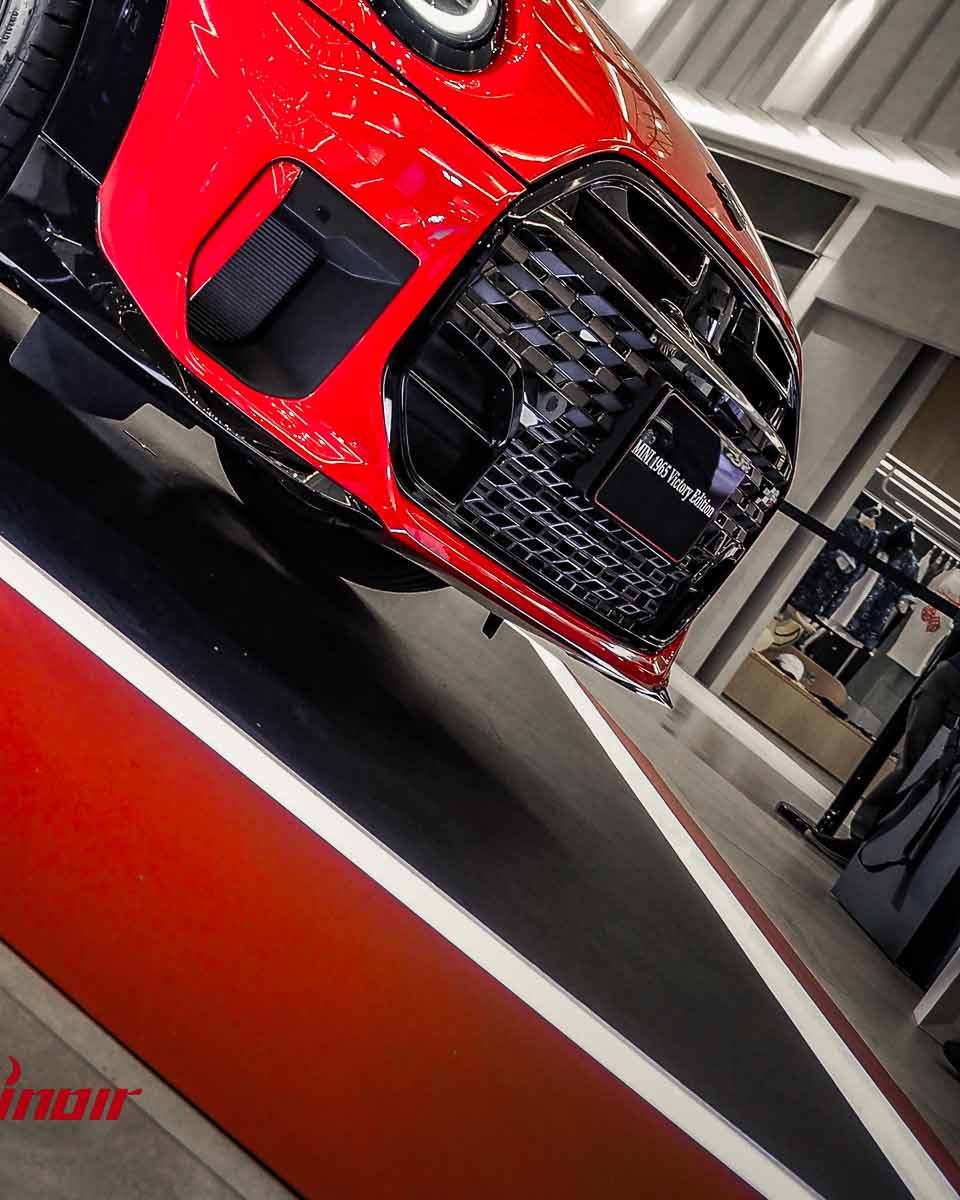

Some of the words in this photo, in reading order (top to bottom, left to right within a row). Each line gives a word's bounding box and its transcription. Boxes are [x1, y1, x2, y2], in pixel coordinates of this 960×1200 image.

[631, 439, 657, 467] MINI
[649, 455, 672, 479] 1965
[666, 467, 694, 502] Victory
[688, 488, 715, 518] Edition
